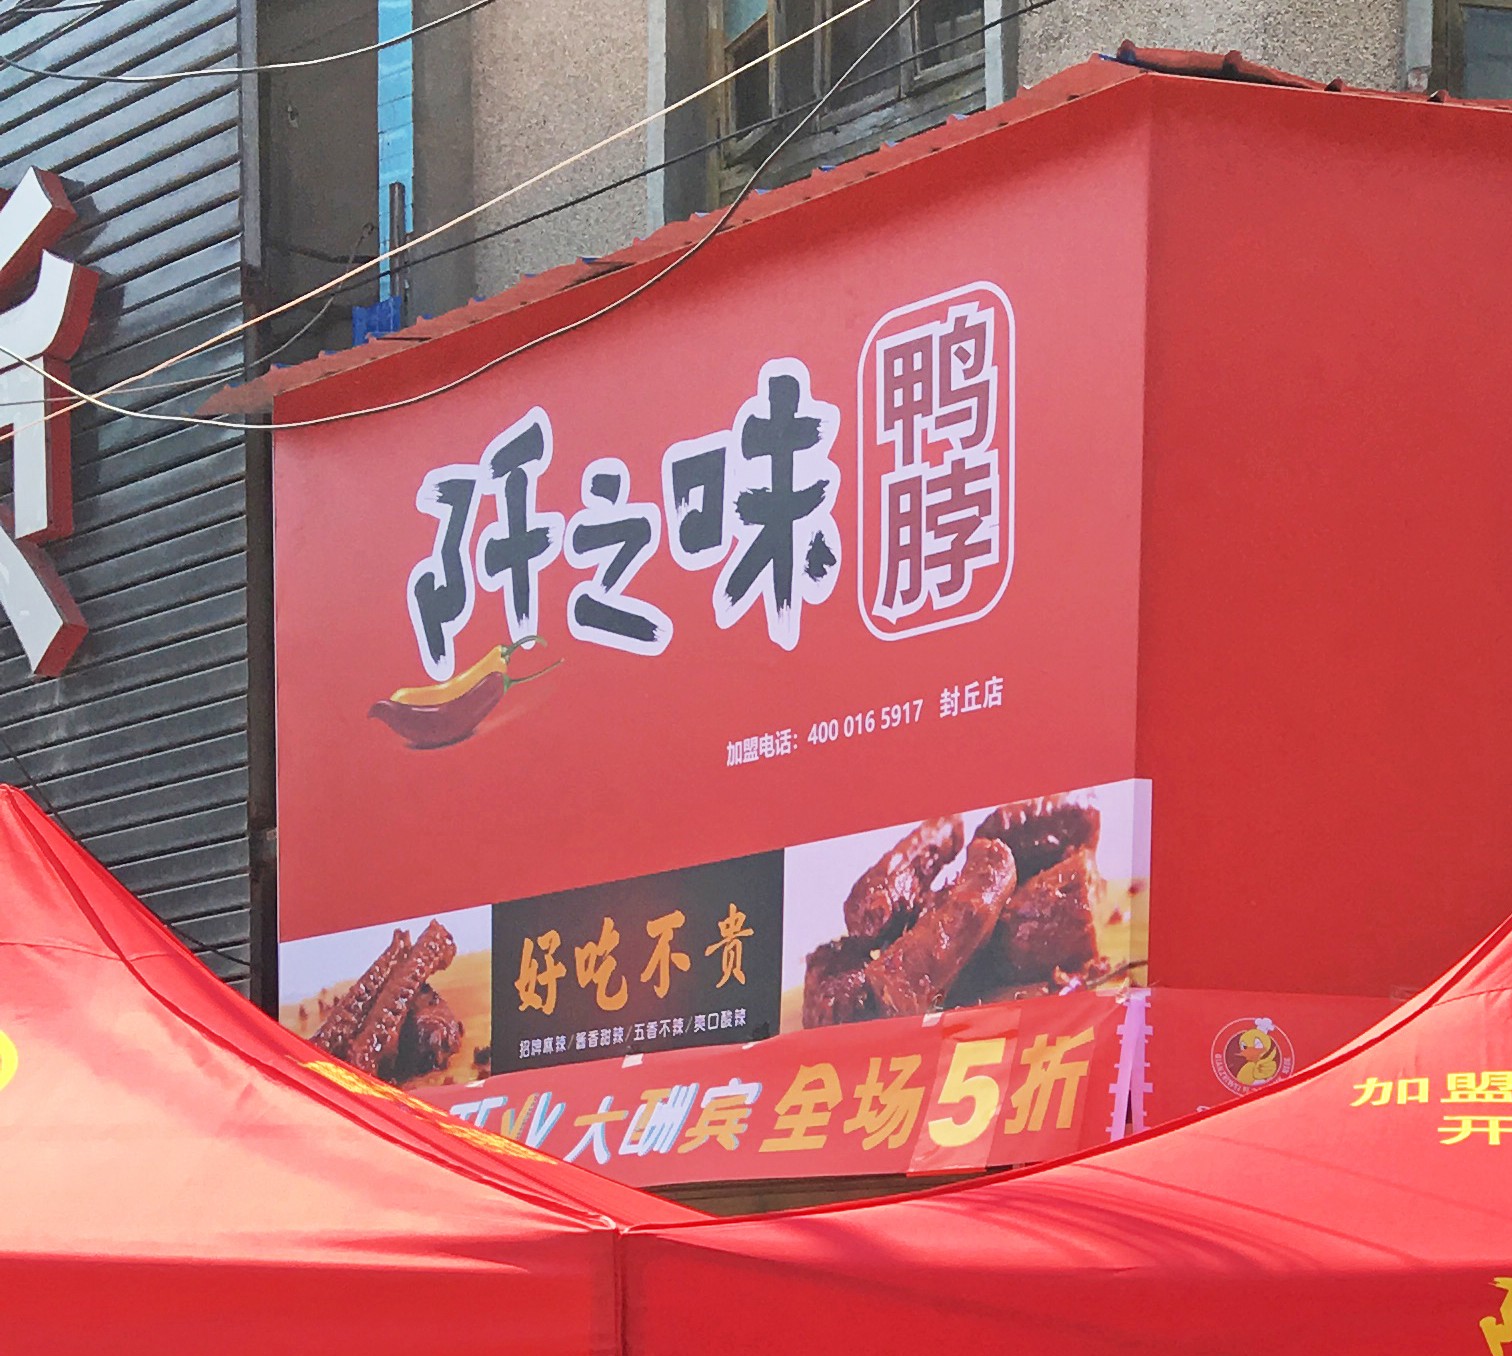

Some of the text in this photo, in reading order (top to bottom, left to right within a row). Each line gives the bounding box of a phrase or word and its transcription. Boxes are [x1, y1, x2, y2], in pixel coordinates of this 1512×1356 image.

[872, 301, 999, 624] 鸭脖
[726, 675, 1004, 767] 加盟电话： 400 016 5917 封丘店
[514, 903, 754, 1015] 好吃不贵
